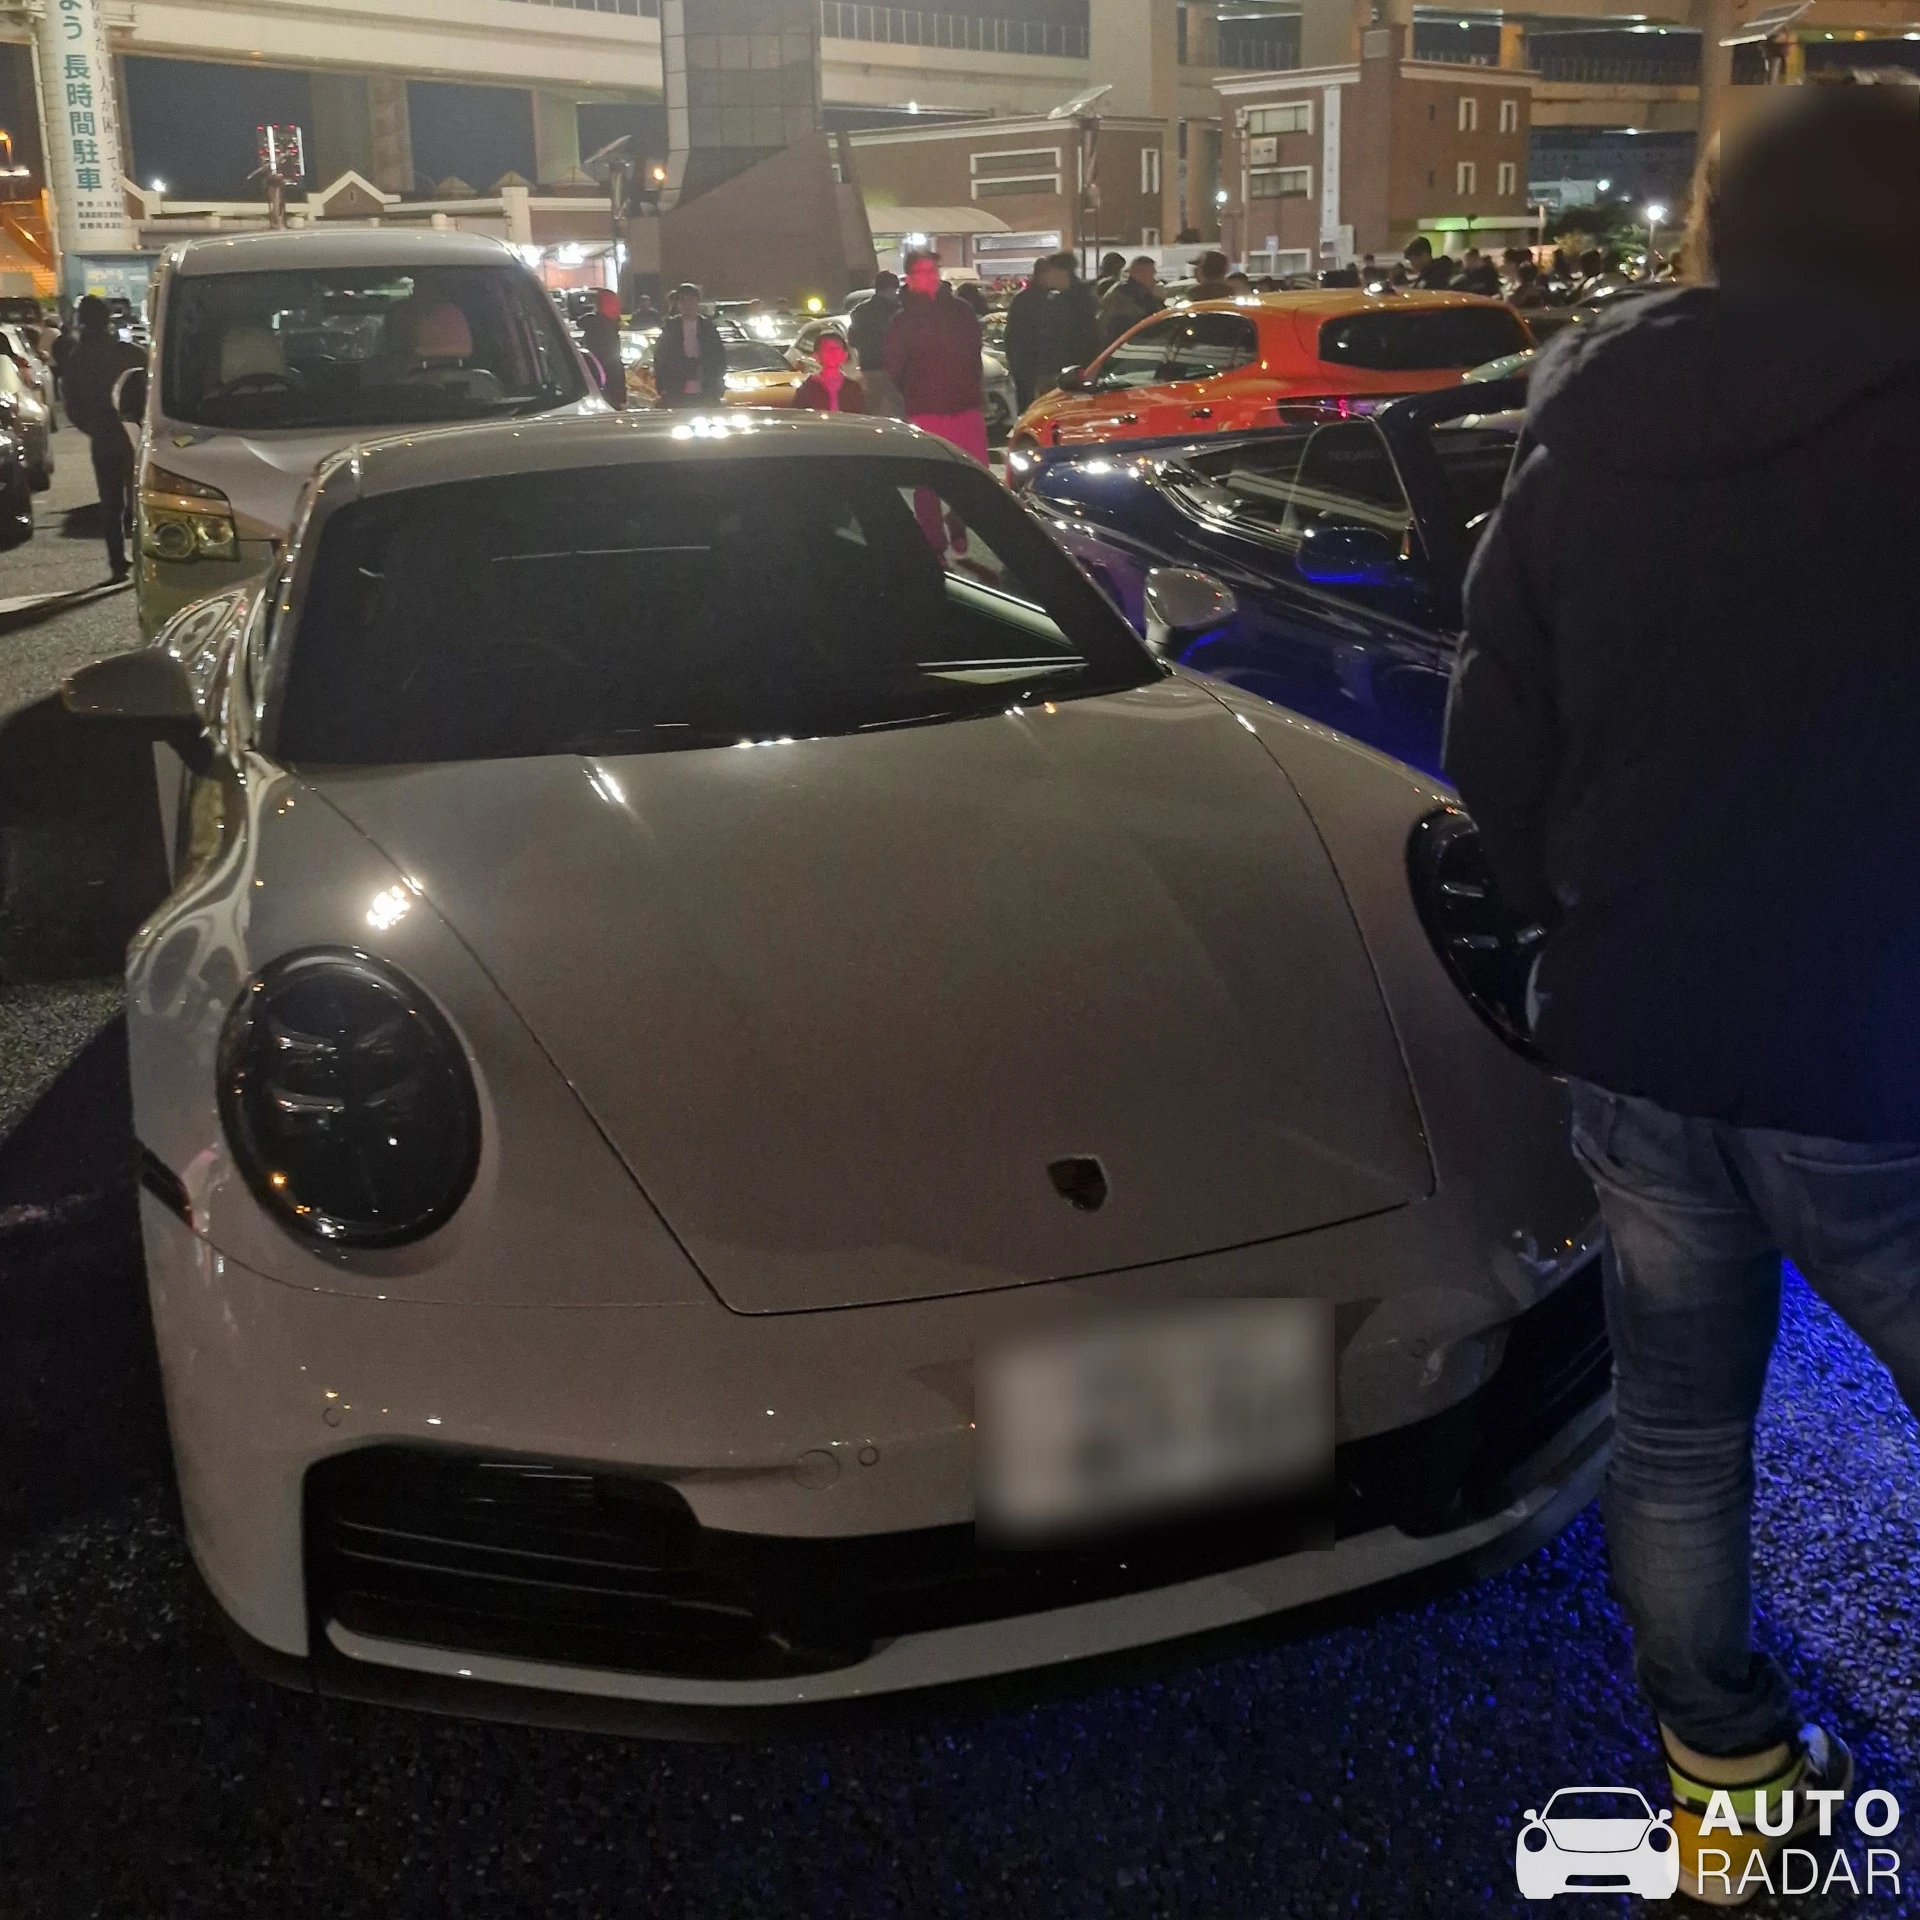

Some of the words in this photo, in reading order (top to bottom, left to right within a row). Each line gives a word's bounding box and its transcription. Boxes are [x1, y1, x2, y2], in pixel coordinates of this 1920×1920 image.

[64, 54, 102, 193] 長時間駐車
